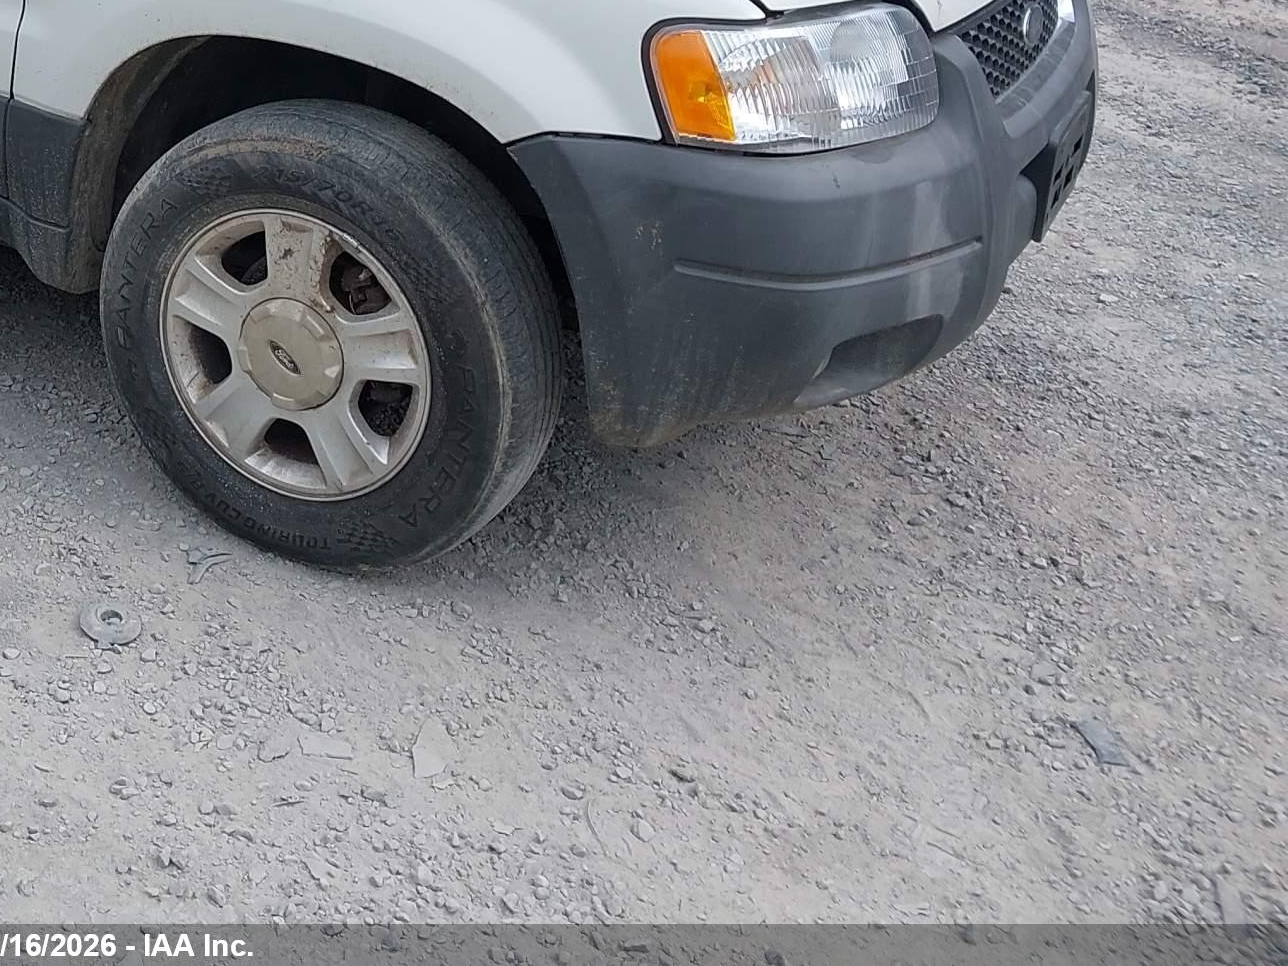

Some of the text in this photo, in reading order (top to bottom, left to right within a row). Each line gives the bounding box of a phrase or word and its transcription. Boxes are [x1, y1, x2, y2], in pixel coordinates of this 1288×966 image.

[116, 198, 179, 349] PANTERA
[397, 367, 480, 528] PANTERA
[242, 516, 332, 551] TOURING
